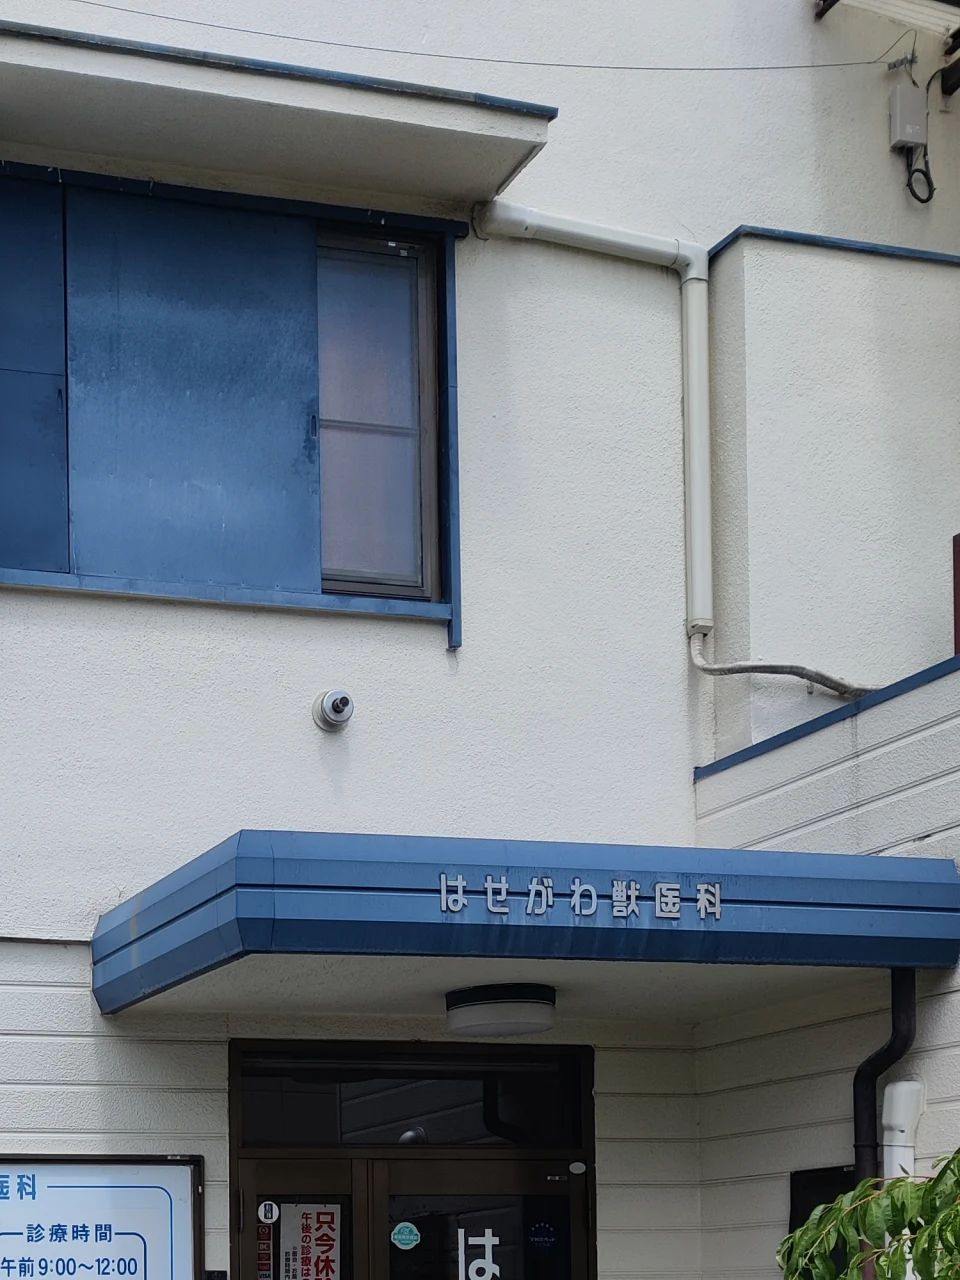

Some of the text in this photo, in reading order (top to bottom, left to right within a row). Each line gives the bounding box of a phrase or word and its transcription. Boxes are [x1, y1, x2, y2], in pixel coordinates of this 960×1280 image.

[440, 873, 721, 920] はせがわ獣医科
[26, 1223, 113, 1243] 診療時間
